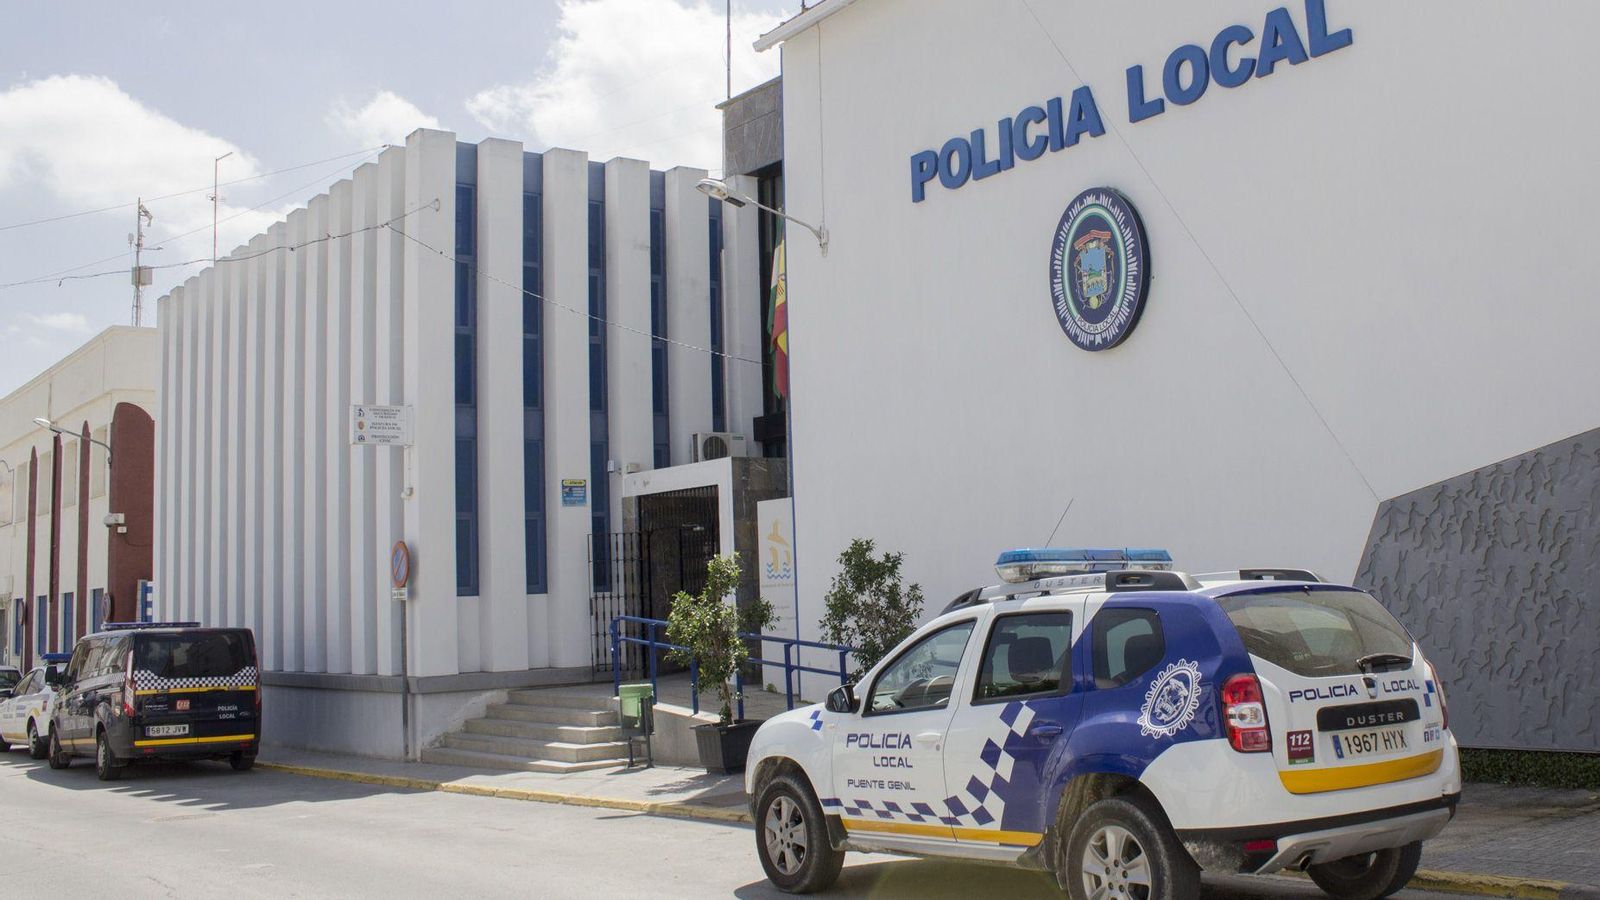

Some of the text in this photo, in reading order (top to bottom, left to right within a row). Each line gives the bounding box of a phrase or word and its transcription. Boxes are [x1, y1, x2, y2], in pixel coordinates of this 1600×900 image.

[910, 0, 1353, 203] POLICIA LOCAL
[1033, 576, 1102, 589] DUSTER
[1382, 679, 1420, 693] LOCAL
[1347, 712, 1404, 726] DUSTER
[1289, 733, 1310, 746] 112
[1344, 730, 1407, 755] 1967 HYX
[873, 756, 913, 768] LOCAL
[847, 779, 916, 791] PUENTE GENIL
